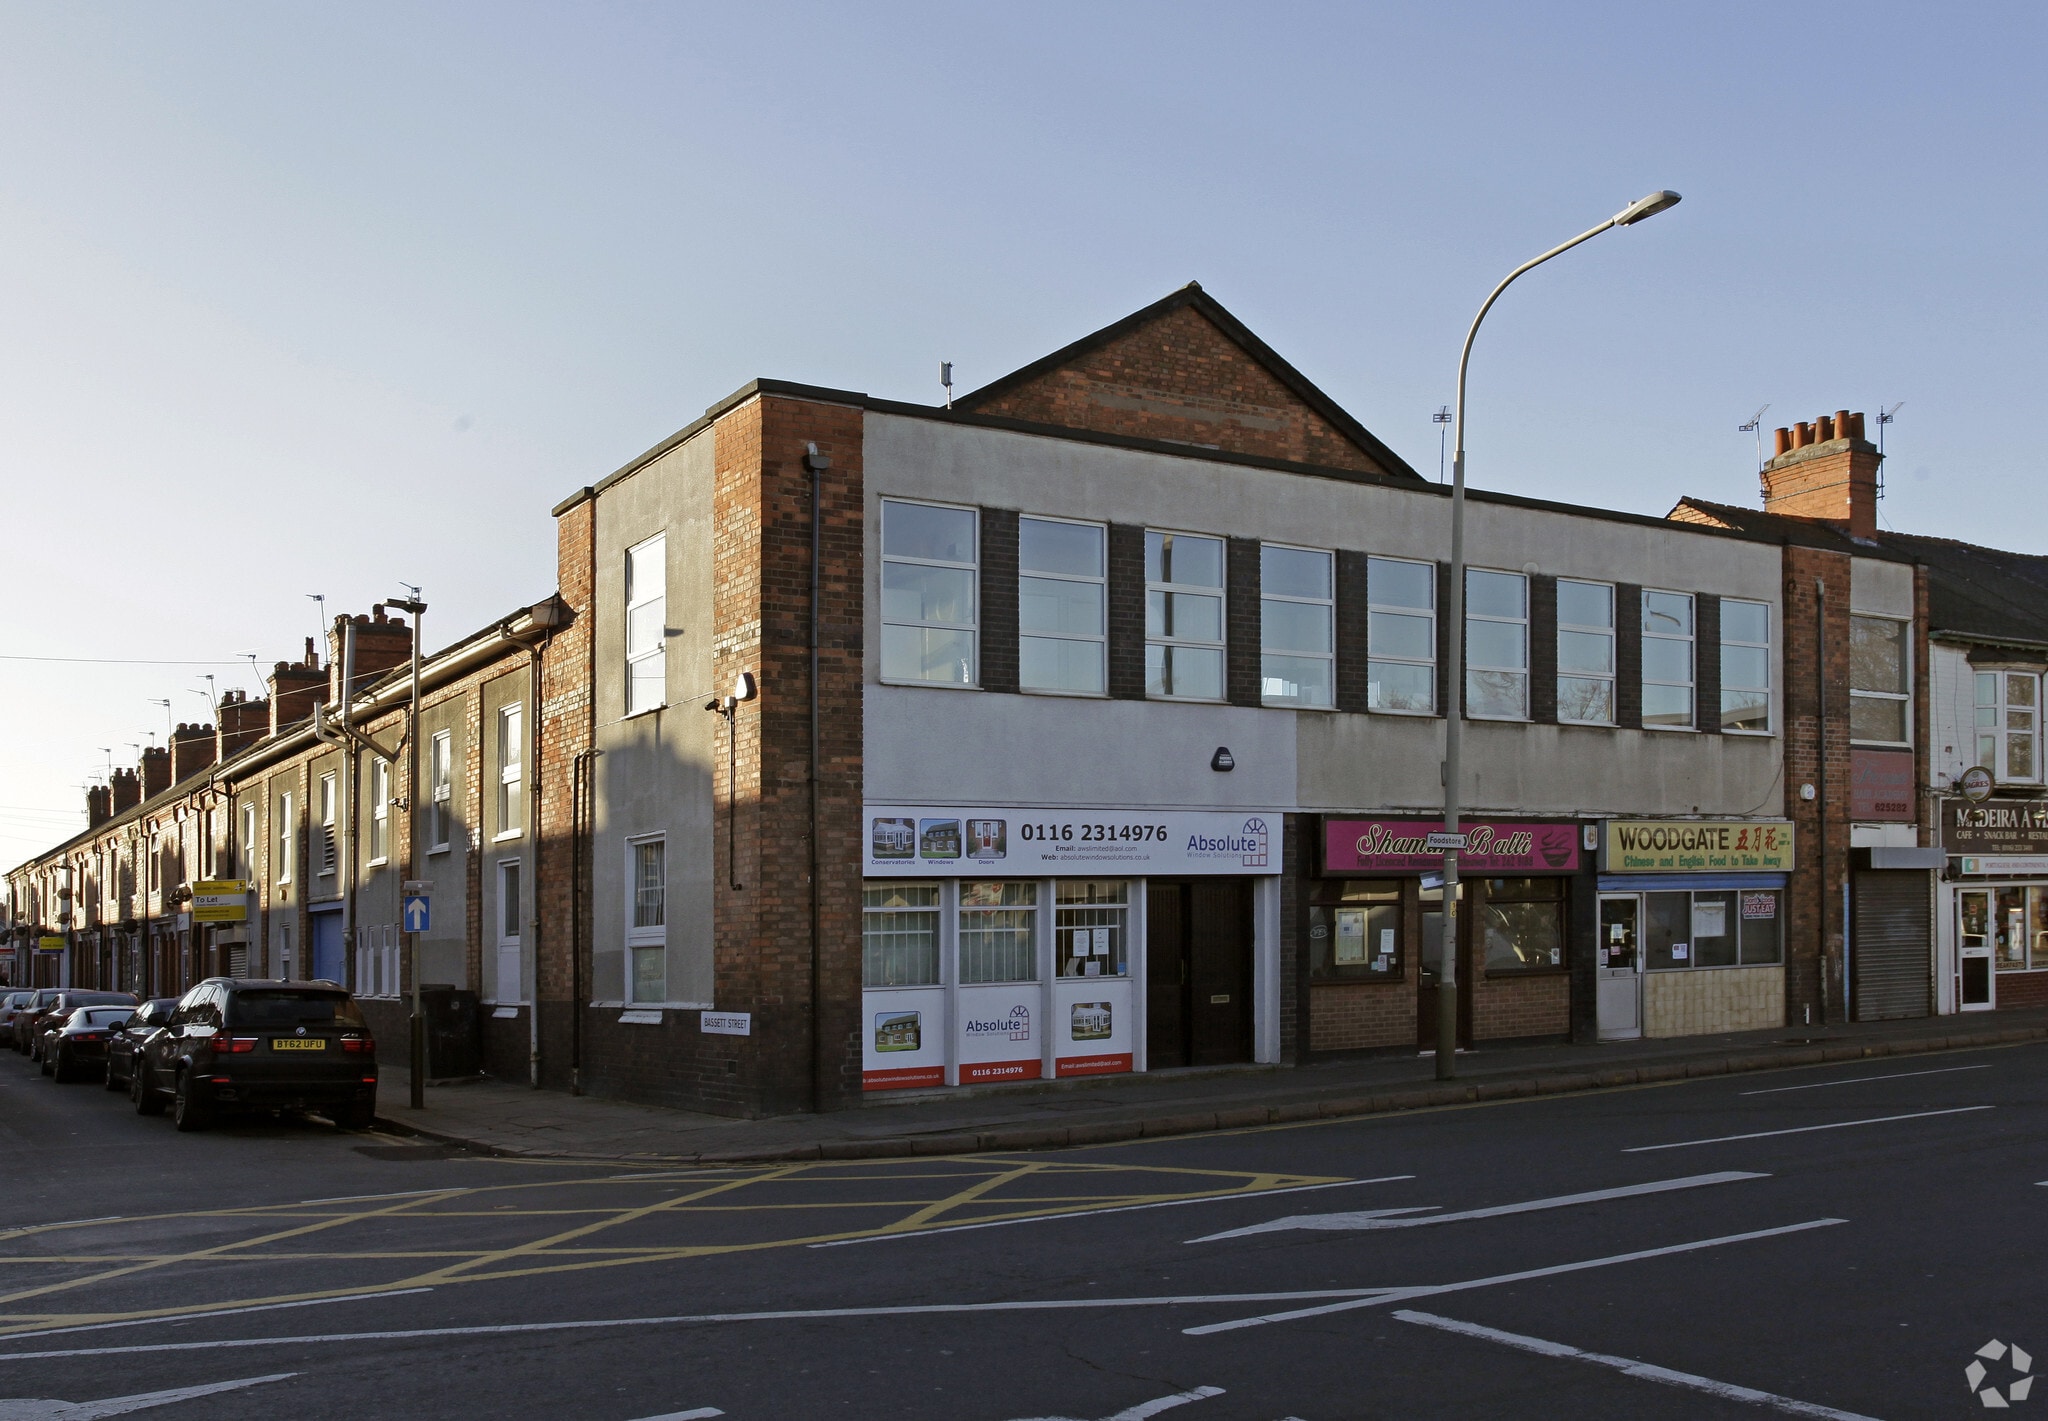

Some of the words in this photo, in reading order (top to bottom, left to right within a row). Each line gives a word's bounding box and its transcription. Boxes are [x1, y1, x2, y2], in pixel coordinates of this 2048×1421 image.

[1874, 803, 1907, 812] 625282
[1021, 823, 1073, 841] 0116
[1081, 824, 1168, 841] 2314976
[1956, 831, 1972, 839] CAFE
[1984, 831, 2004, 840] SNACK
[2005, 832, 2017, 840] BAR
[1187, 834, 1257, 852] Absolute
[1429, 836, 1461, 844] Foodstore
[1618, 827, 1730, 851] WOODGATE
[1735, 827, 1778, 851] 五月花
[1624, 855, 1655, 867] Chinese
[1659, 855, 1673, 866] and
[1679, 855, 1705, 868] English
[1709, 855, 1727, 866] Food
[1731, 855, 1739, 866] to
[1742, 855, 1758, 866] Take
[1763, 855, 1782, 868] Away
[1744, 904, 1761, 913] JUST
[1761, 904, 1774, 913] EAT
[704, 1018, 726, 1028] BASSETT
[728, 1019, 747, 1029] STREET
[965, 1019, 1021, 1032] Absolute
[972, 1068, 991, 1076] 0116
[992, 1066, 1023, 1075] 2314976
